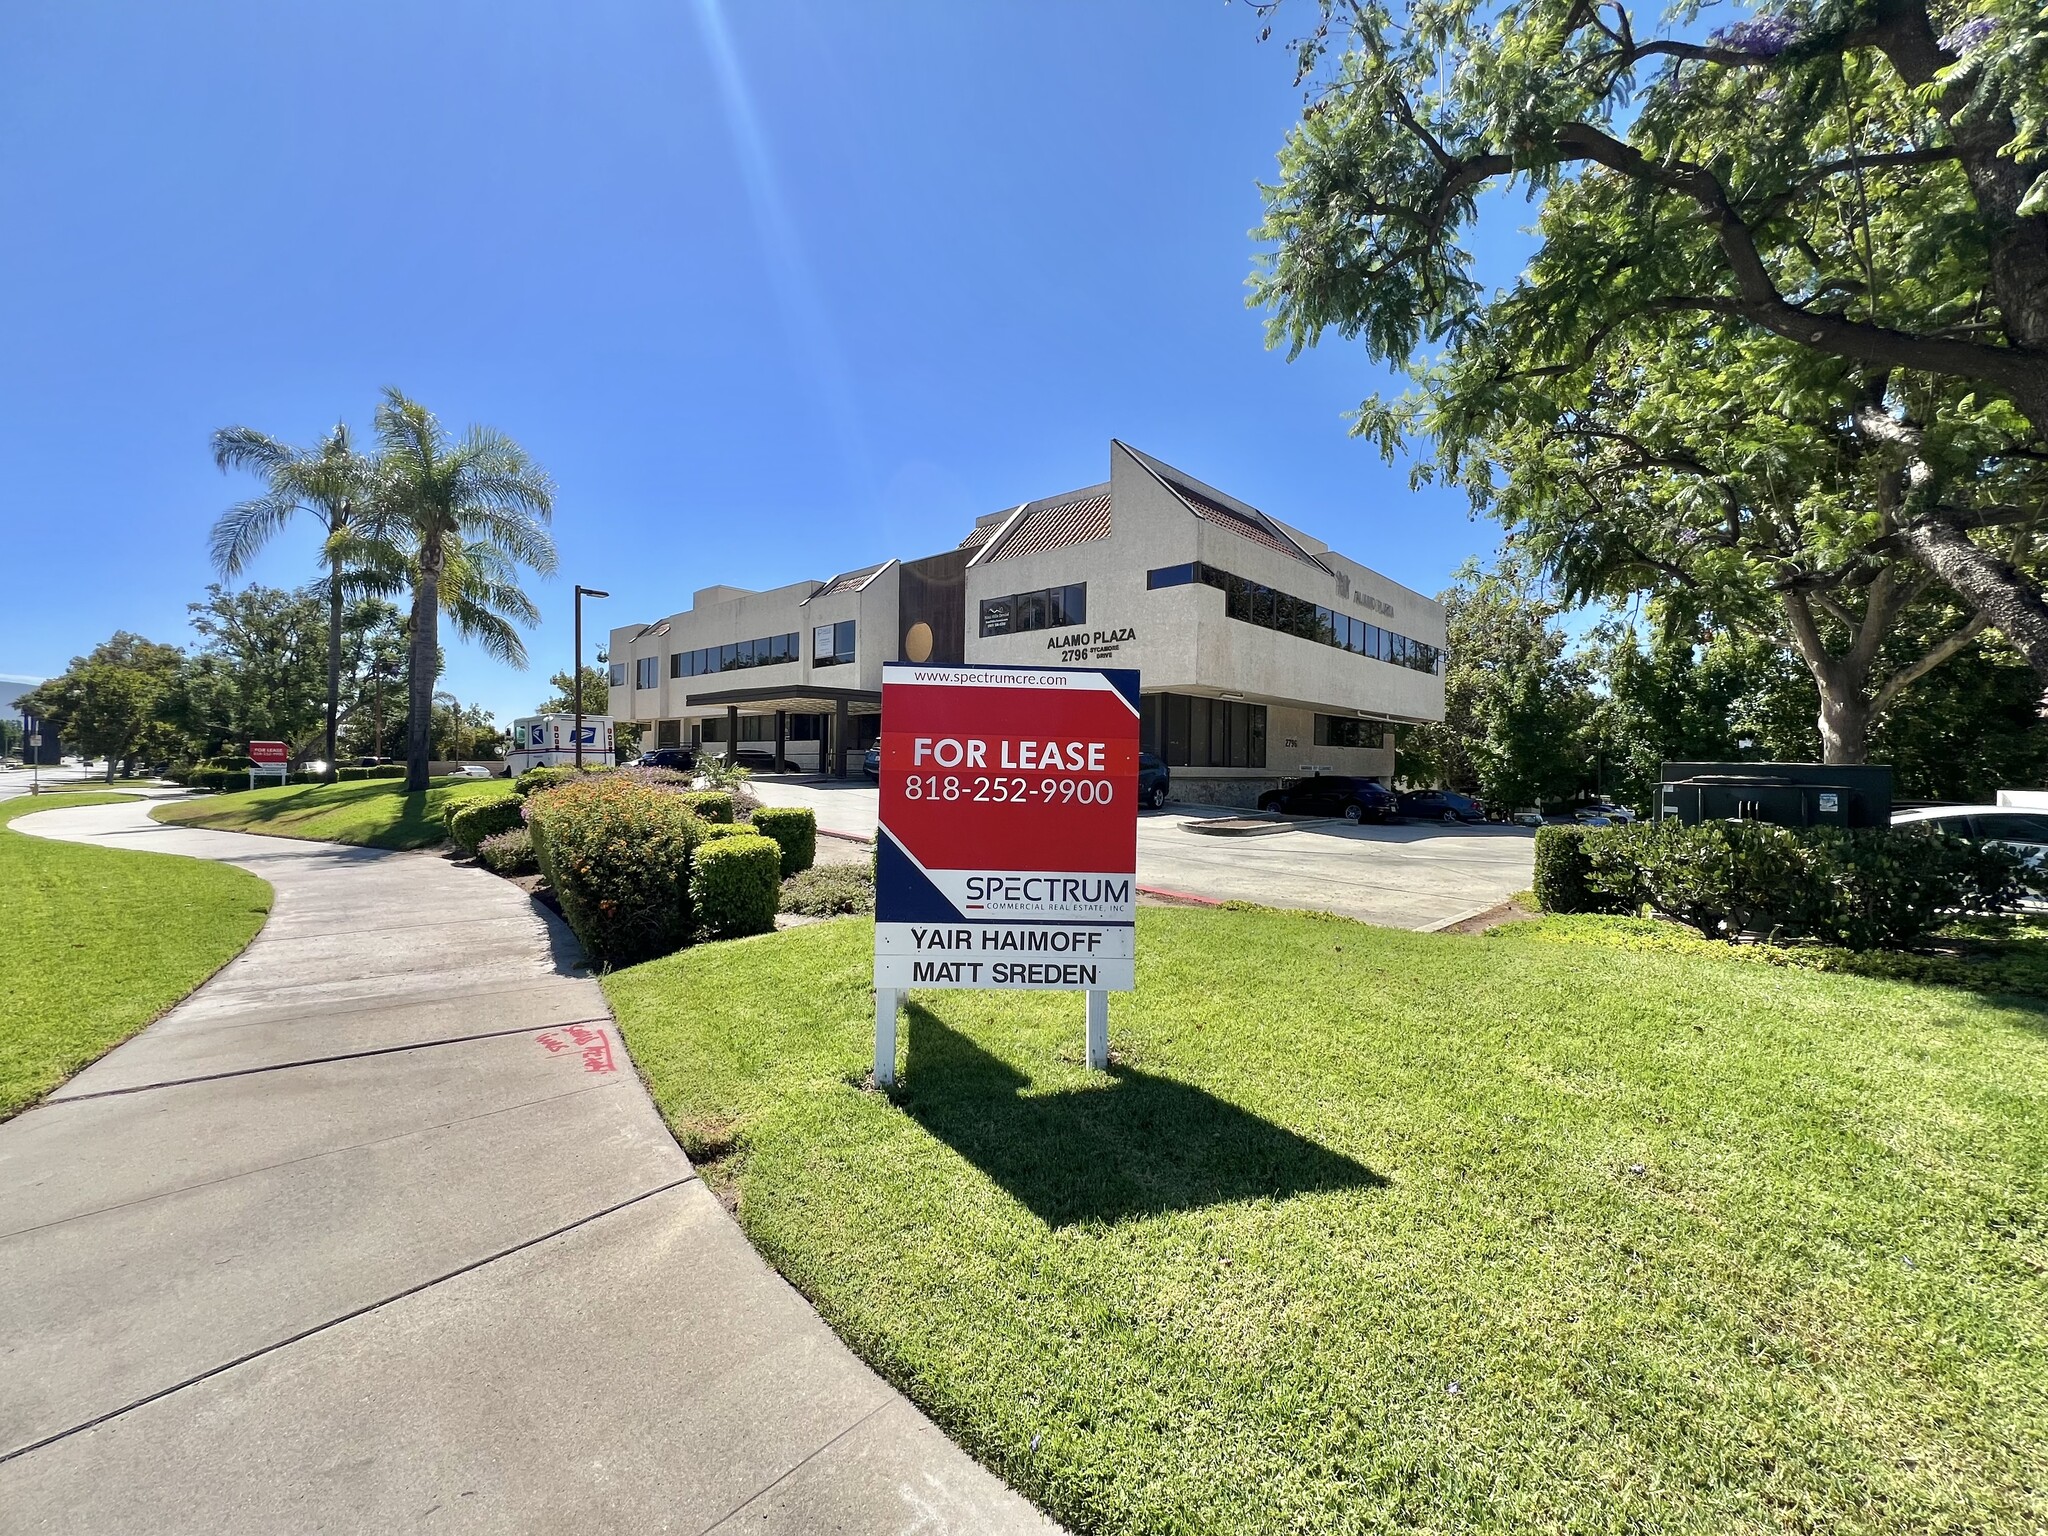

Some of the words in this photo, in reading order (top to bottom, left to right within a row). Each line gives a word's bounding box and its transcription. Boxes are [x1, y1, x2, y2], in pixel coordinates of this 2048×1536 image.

[1047, 633, 1090, 649] ALAMO
[1093, 628, 1136, 644] PLAZA
[1061, 648, 1088, 662] 2796
[914, 672, 1067, 685] www.spectrumcre.com
[914, 738, 987, 768] FOR
[1000, 740, 1105, 771] LEASE
[905, 775, 1113, 805] 818-252-9900
[966, 876, 1129, 903] SPECTRUM
[986, 902, 1044, 911] COMMERCIAL
[1073, 904, 1106, 912] ESTATE,
[911, 929, 972, 950] YAIR
[982, 930, 1102, 952] HAIMOFF
[913, 962, 983, 983] MATT
[992, 963, 1097, 985] SREDEN
